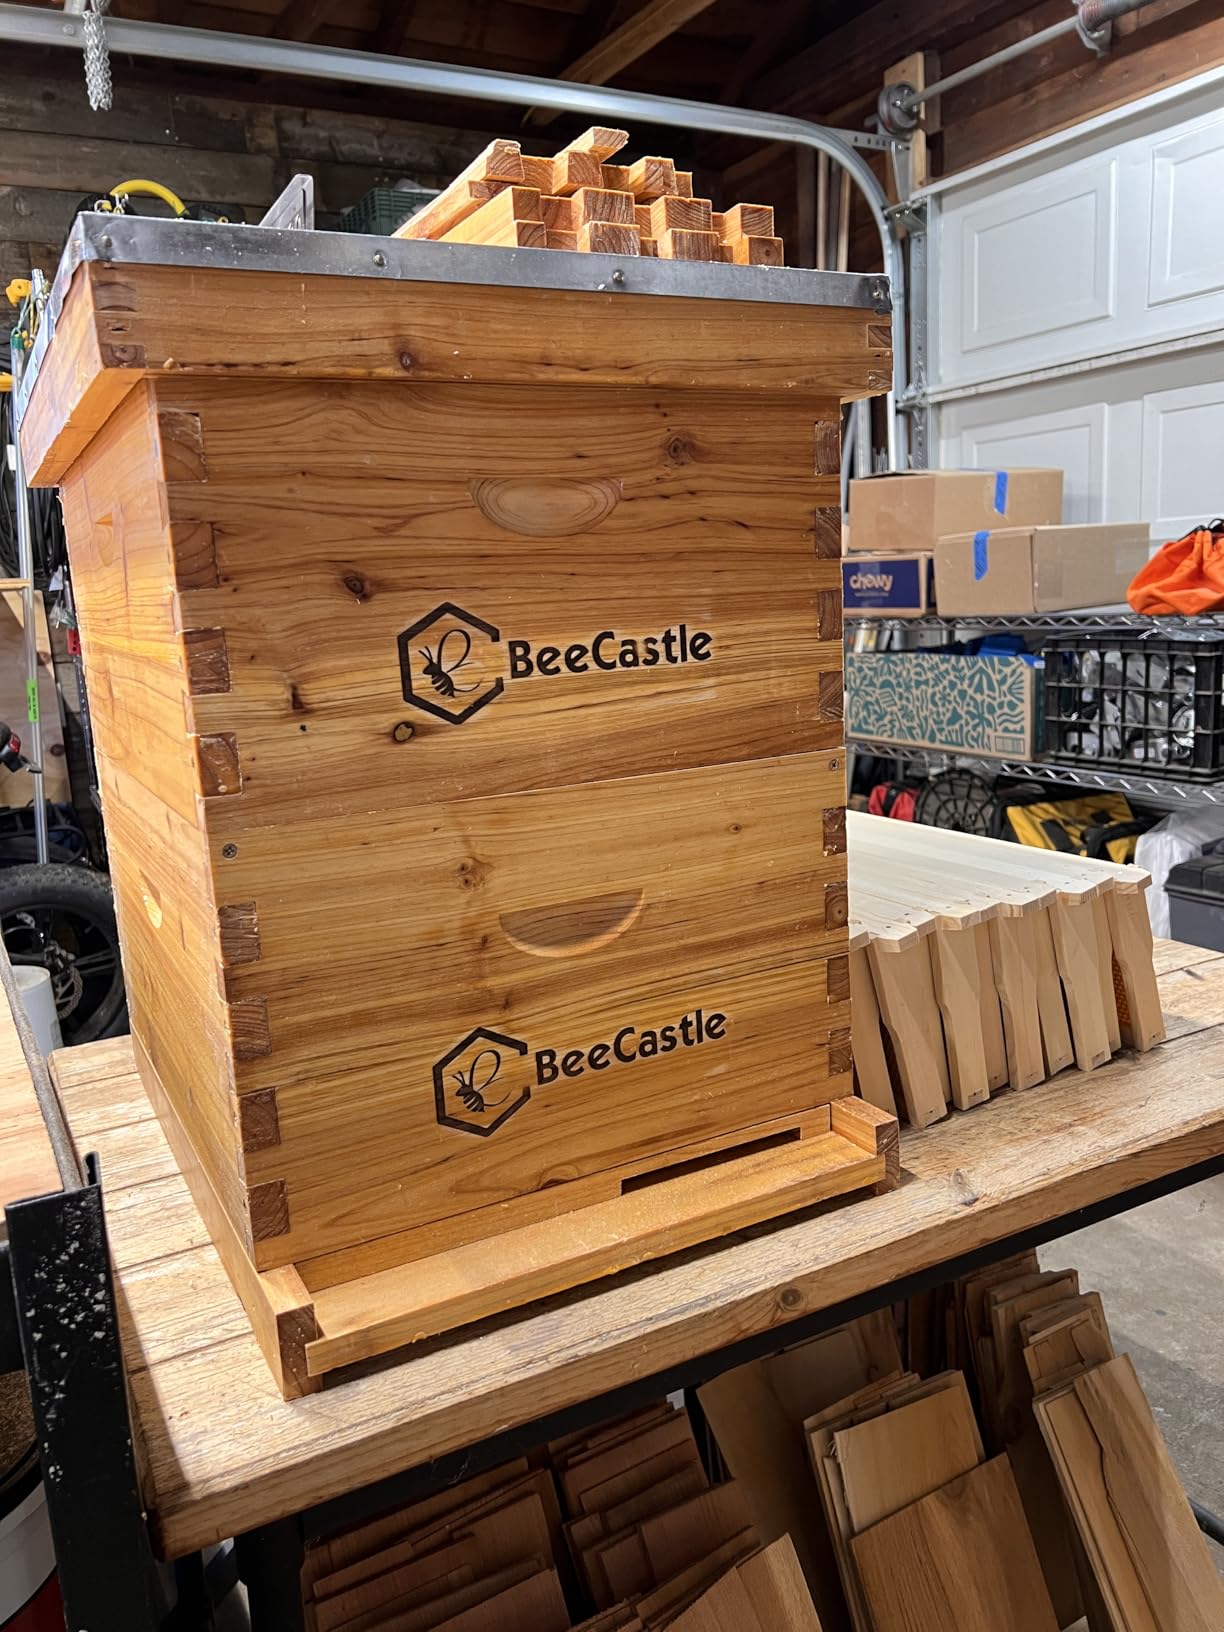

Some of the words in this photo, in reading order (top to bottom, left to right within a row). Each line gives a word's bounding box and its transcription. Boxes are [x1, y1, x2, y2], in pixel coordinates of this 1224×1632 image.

[849, 573, 893, 592] chewy
[508, 624, 713, 679] BeeCastle
[535, 1009, 727, 1086] BeeCastle
